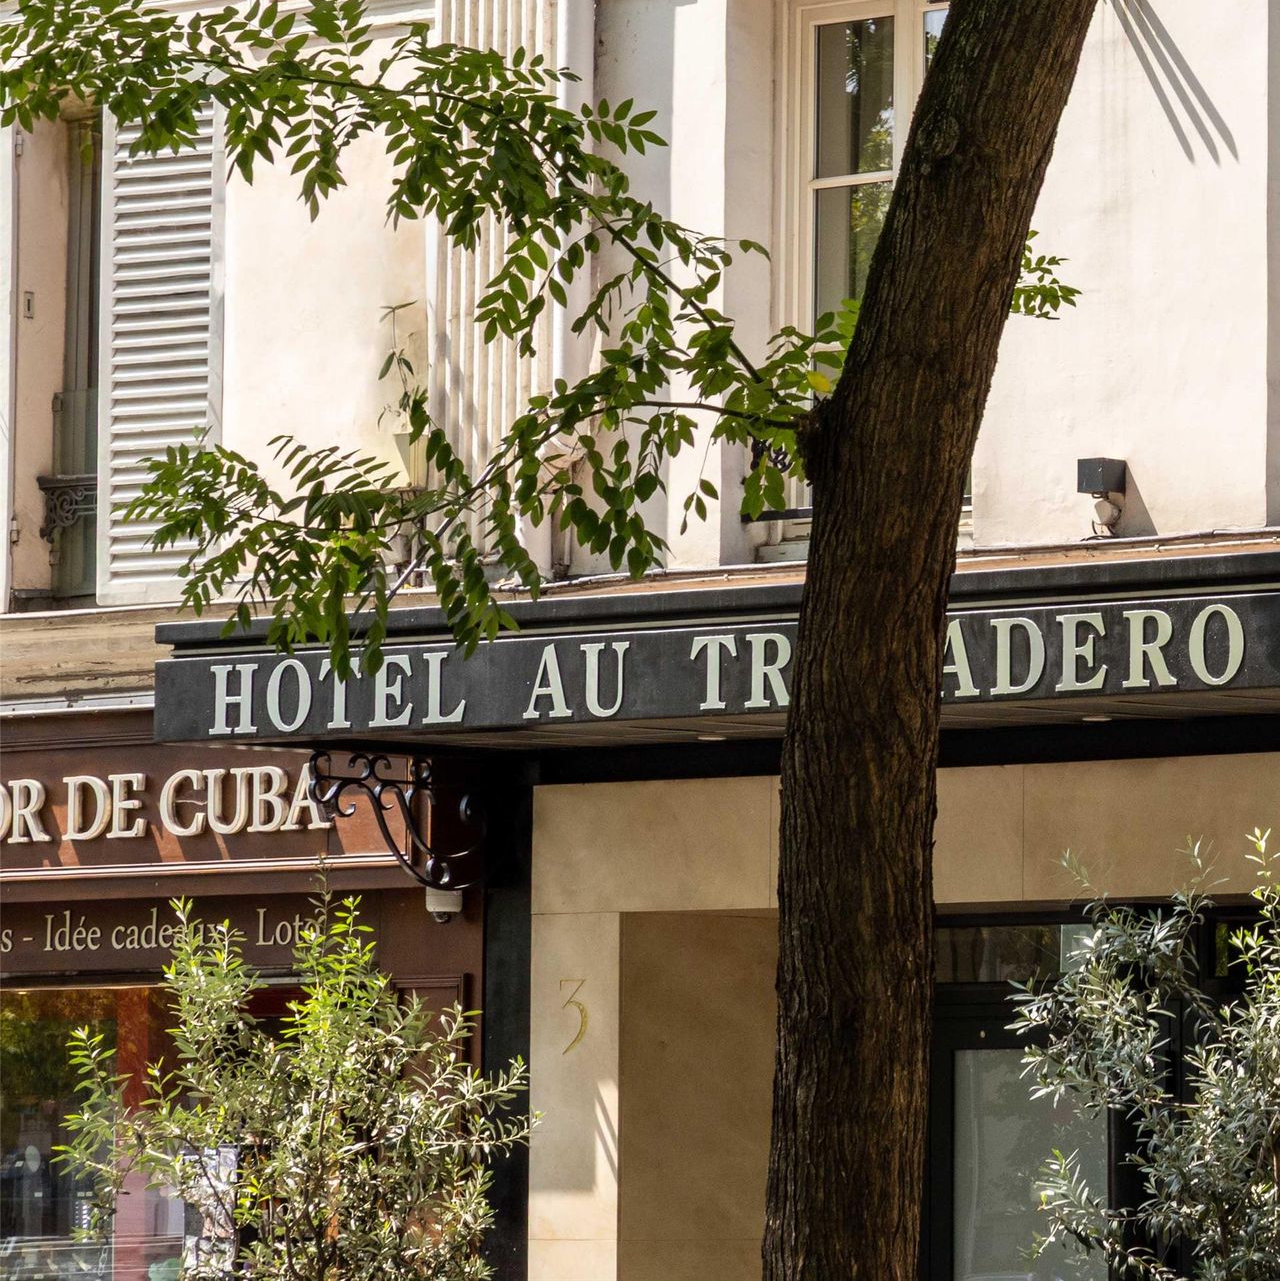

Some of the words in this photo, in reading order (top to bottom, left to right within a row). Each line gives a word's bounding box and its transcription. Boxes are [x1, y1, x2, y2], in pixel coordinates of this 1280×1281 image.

[208, 650, 466, 736] HOTEL
[523, 640, 631, 719] AU
[690, 603, 1246, 711] TRADERO
[61, 772, 147, 841] DE
[159, 762, 335, 837] CUBA
[43, 909, 101, 951] Idée
[256, 908, 321, 946] Loto
[558, 978, 590, 1057] 3
